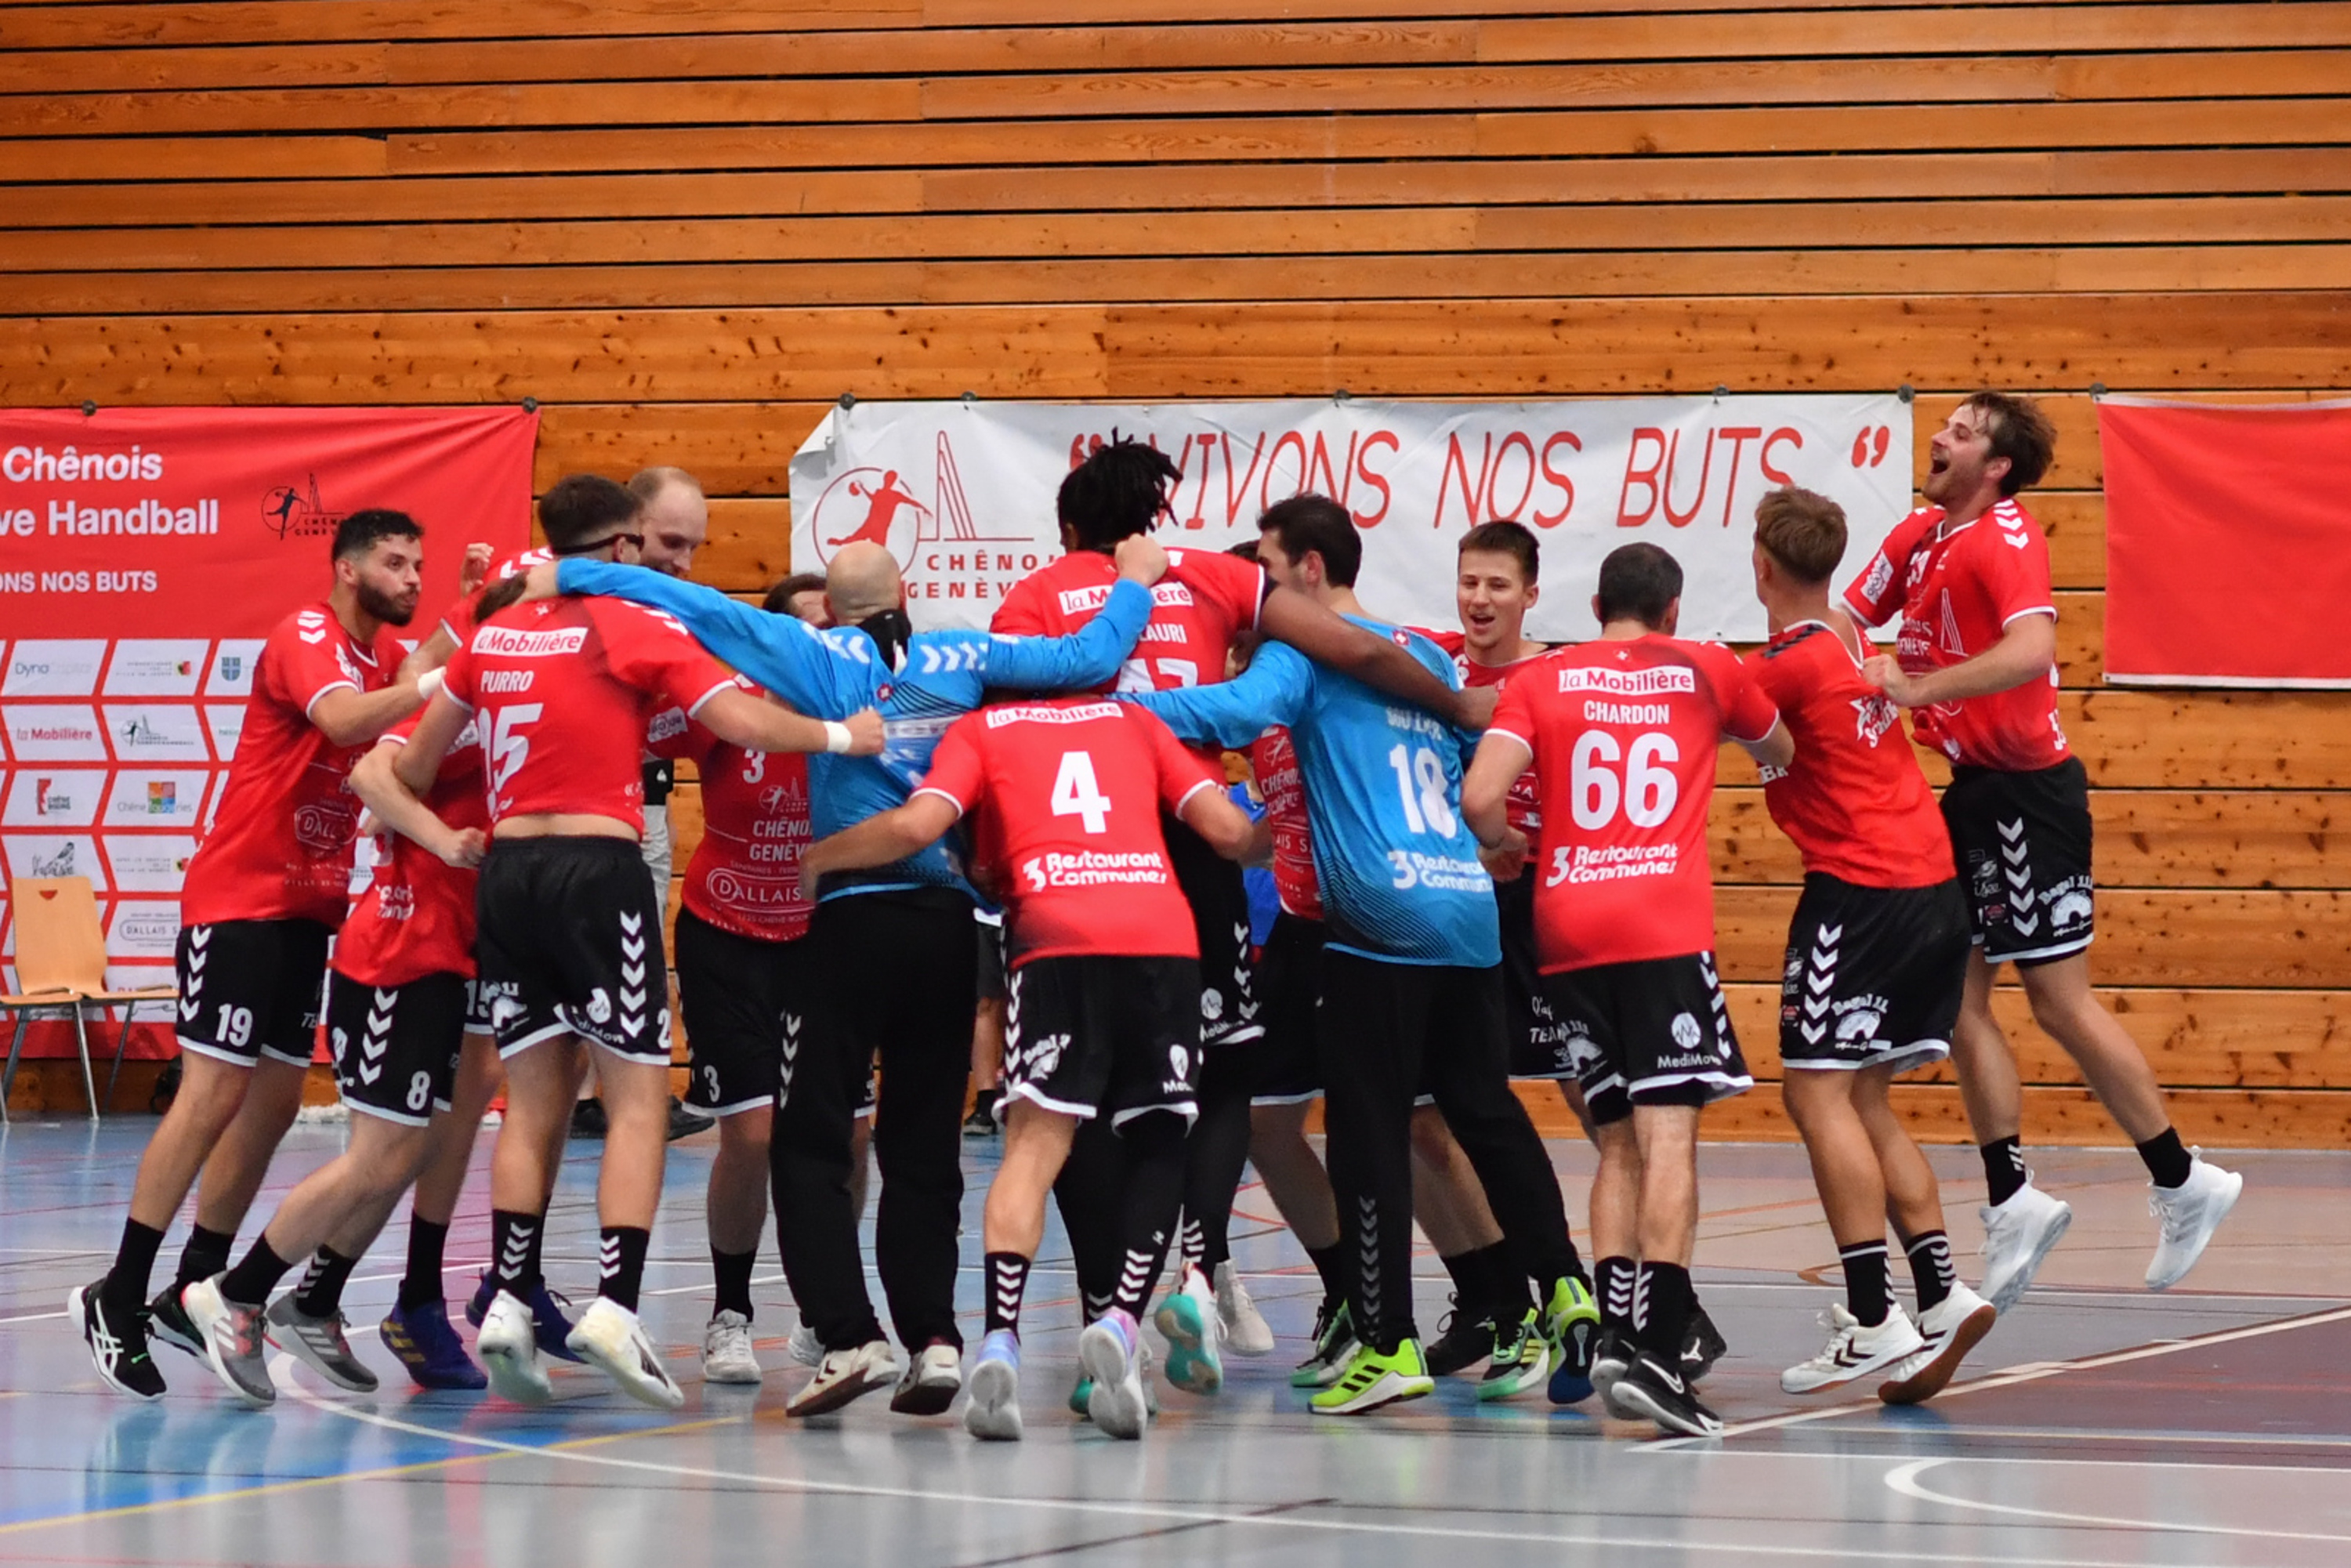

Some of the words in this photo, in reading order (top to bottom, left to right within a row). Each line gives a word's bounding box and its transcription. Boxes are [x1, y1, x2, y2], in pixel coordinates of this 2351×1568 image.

[3, 445, 163, 482] Chênois
[1434, 431, 1581, 529] NOS
[1617, 426, 1803, 527] BUTS
[48, 498, 219, 535] Handball
[926, 549, 1056, 571] CHÊNO
[0, 570, 35, 593] NS
[41, 571, 89, 592] NOS
[96, 570, 158, 592] BUTS
[907, 577, 1016, 599] GENÈV
[1065, 592, 1085, 610] la
[487, 629, 581, 654] Mobilière
[480, 670, 534, 693] PURRO
[1562, 671, 1581, 688] la
[1586, 670, 1693, 693] Mobilière
[1013, 703, 1120, 723] Mobilière
[1583, 699, 1670, 725] CHARDON
[31, 727, 93, 741] Mobilière
[742, 748, 766, 784] 3
[1050, 751, 1112, 835] 4
[1389, 743, 1458, 839] 18
[1570, 729, 1679, 831] 66
[752, 815, 813, 838] CHÊNO
[748, 838, 808, 862] GENÈV
[1023, 856, 1047, 893] 3
[1045, 851, 1164, 872] Restaurant
[1049, 869, 1168, 886] Communes
[1387, 850, 1418, 889] 3
[1545, 846, 1572, 888] 3
[1574, 842, 1678, 867] Restaurant
[1568, 860, 1677, 884] Communes
[718, 878, 802, 904] DALLAIS
[216, 1003, 254, 1048] 19
[406, 1070, 431, 1111] 8
[704, 1065, 721, 1103] 3
